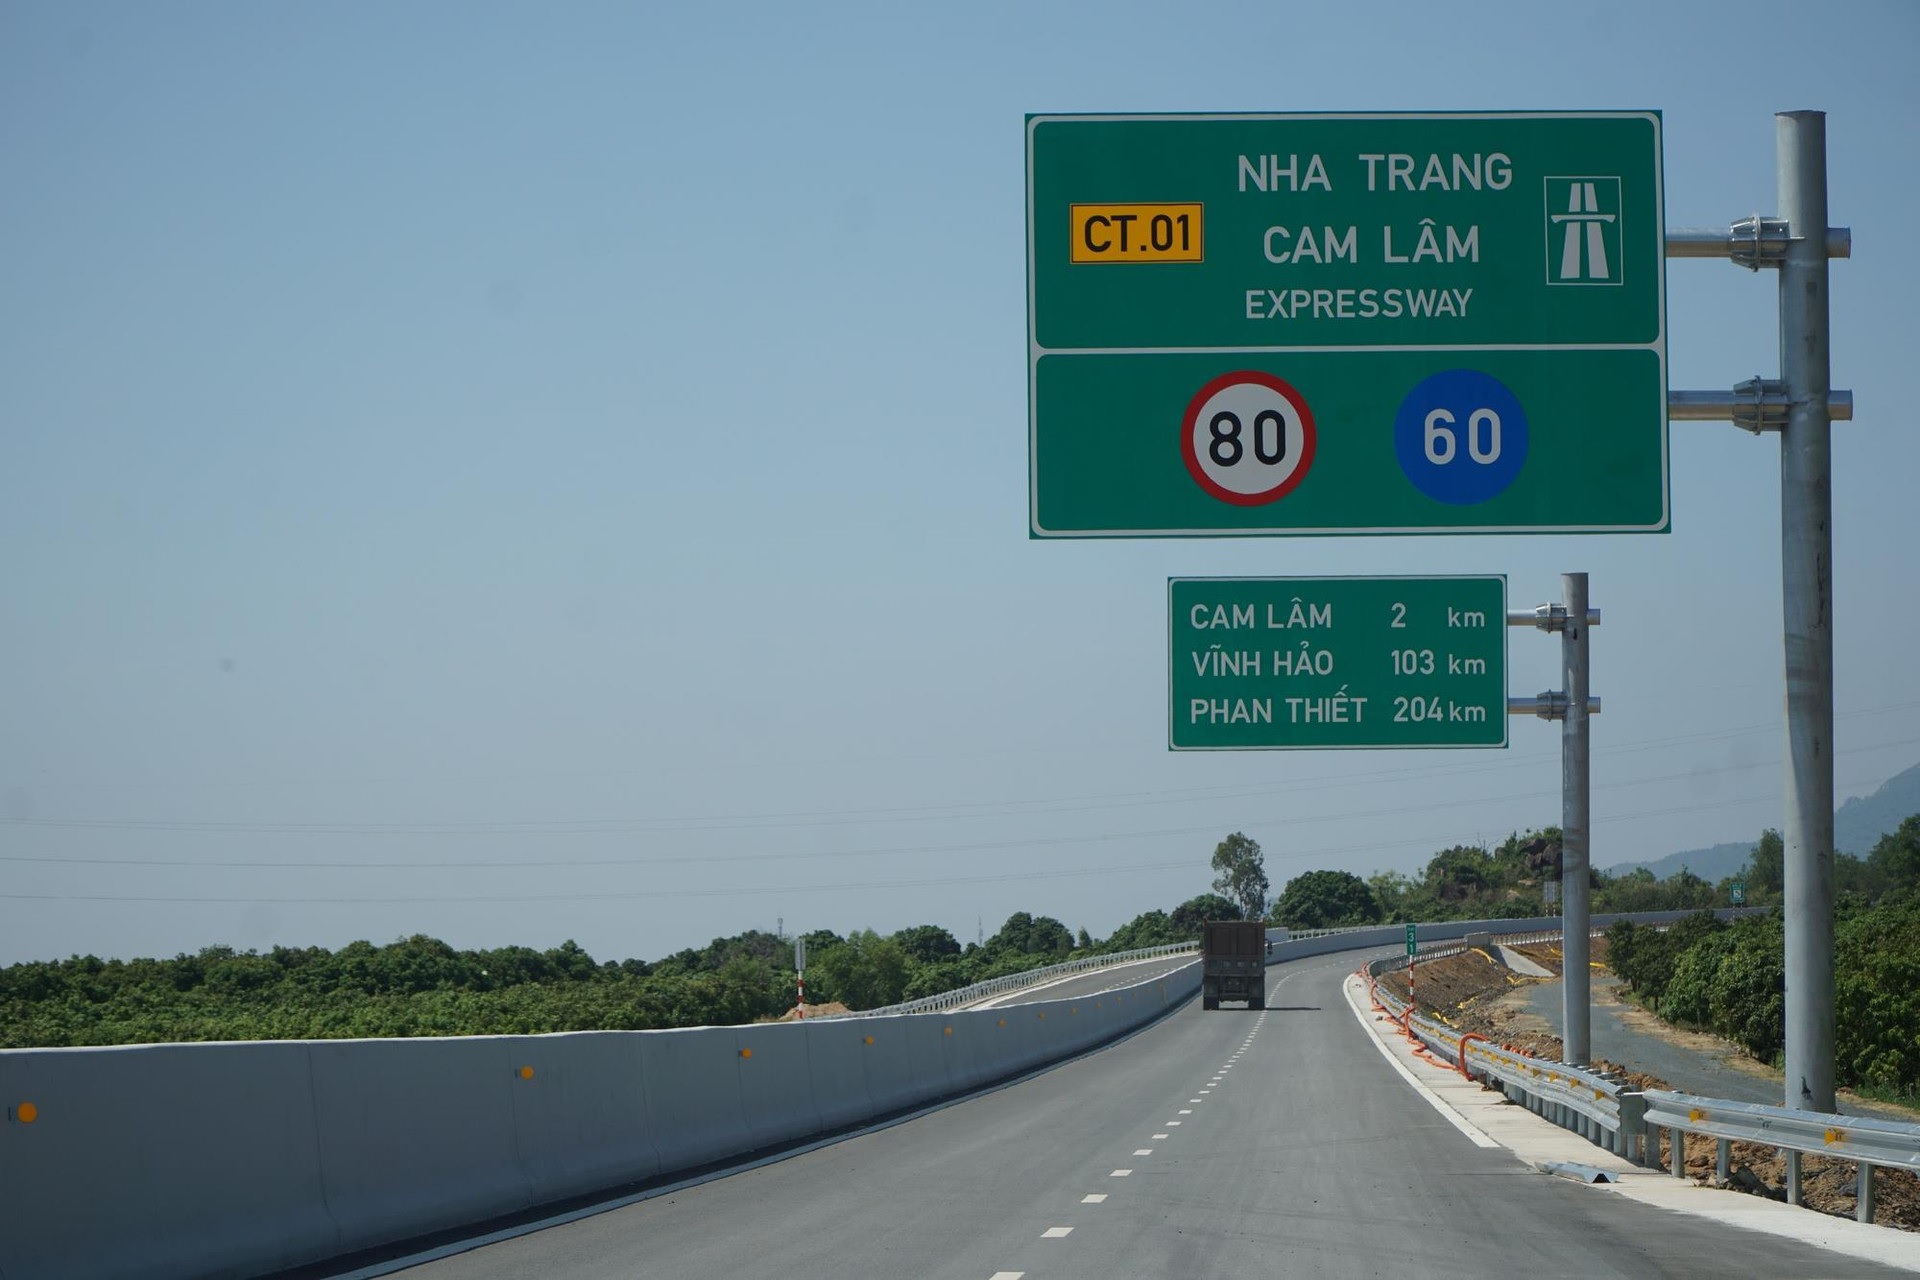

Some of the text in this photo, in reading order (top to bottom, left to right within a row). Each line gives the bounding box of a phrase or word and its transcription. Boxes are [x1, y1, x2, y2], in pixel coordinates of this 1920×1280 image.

[1238, 153, 1512, 192] NHA TRANG
[1084, 213, 1190, 253] CT.01
[1264, 218, 1479, 263] CAM LÂM
[1246, 288, 1472, 319] EXPRESSWAY
[1208, 410, 1287, 467] 80
[1424, 408, 1502, 465] 60
[1190, 597, 1485, 629] CAM LÂM 2 km
[1192, 641, 1486, 676] VĨNH HẢO 103 km
[1191, 685, 1486, 724] PHAN THIẾT 204 km
